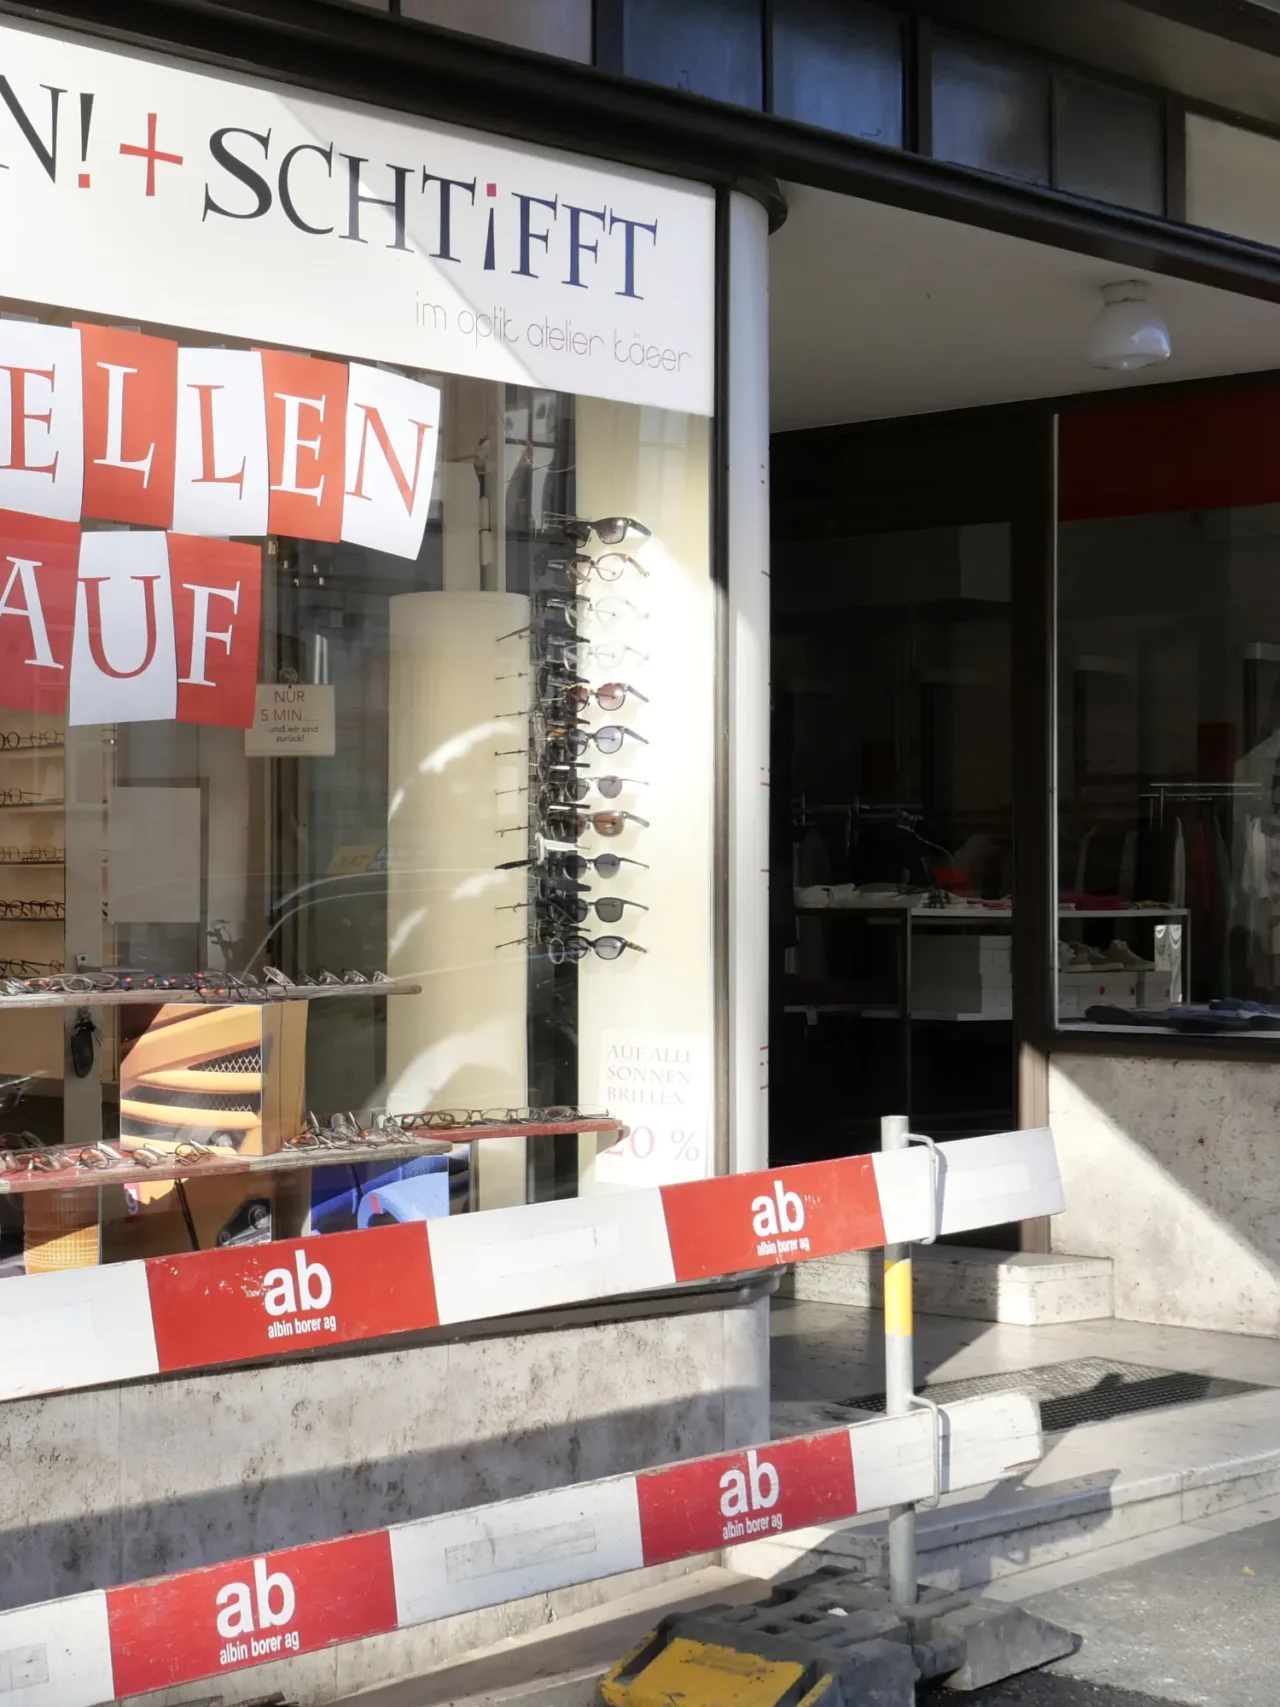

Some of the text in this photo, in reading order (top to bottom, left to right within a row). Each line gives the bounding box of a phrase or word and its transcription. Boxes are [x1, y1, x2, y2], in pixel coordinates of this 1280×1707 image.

[416, 290, 692, 372] im optik atelier käser
[274, 690, 306, 704] NUR
[261, 709, 269, 722] 5
[269, 724, 319, 734] und wir sind
[607, 1044, 694, 1064] AUF ALLE
[607, 1086, 686, 1106] BRILLEN
[751, 1180, 805, 1237] ab
[757, 1237, 810, 1257] albin borer ag
[263, 1249, 332, 1317] ab
[267, 1315, 337, 1339] albin borer ag
[719, 1449, 780, 1518] ab
[723, 1513, 783, 1540] albin borer ag
[216, 1557, 295, 1639] ab
[220, 1631, 300, 1665] albin borer ag
